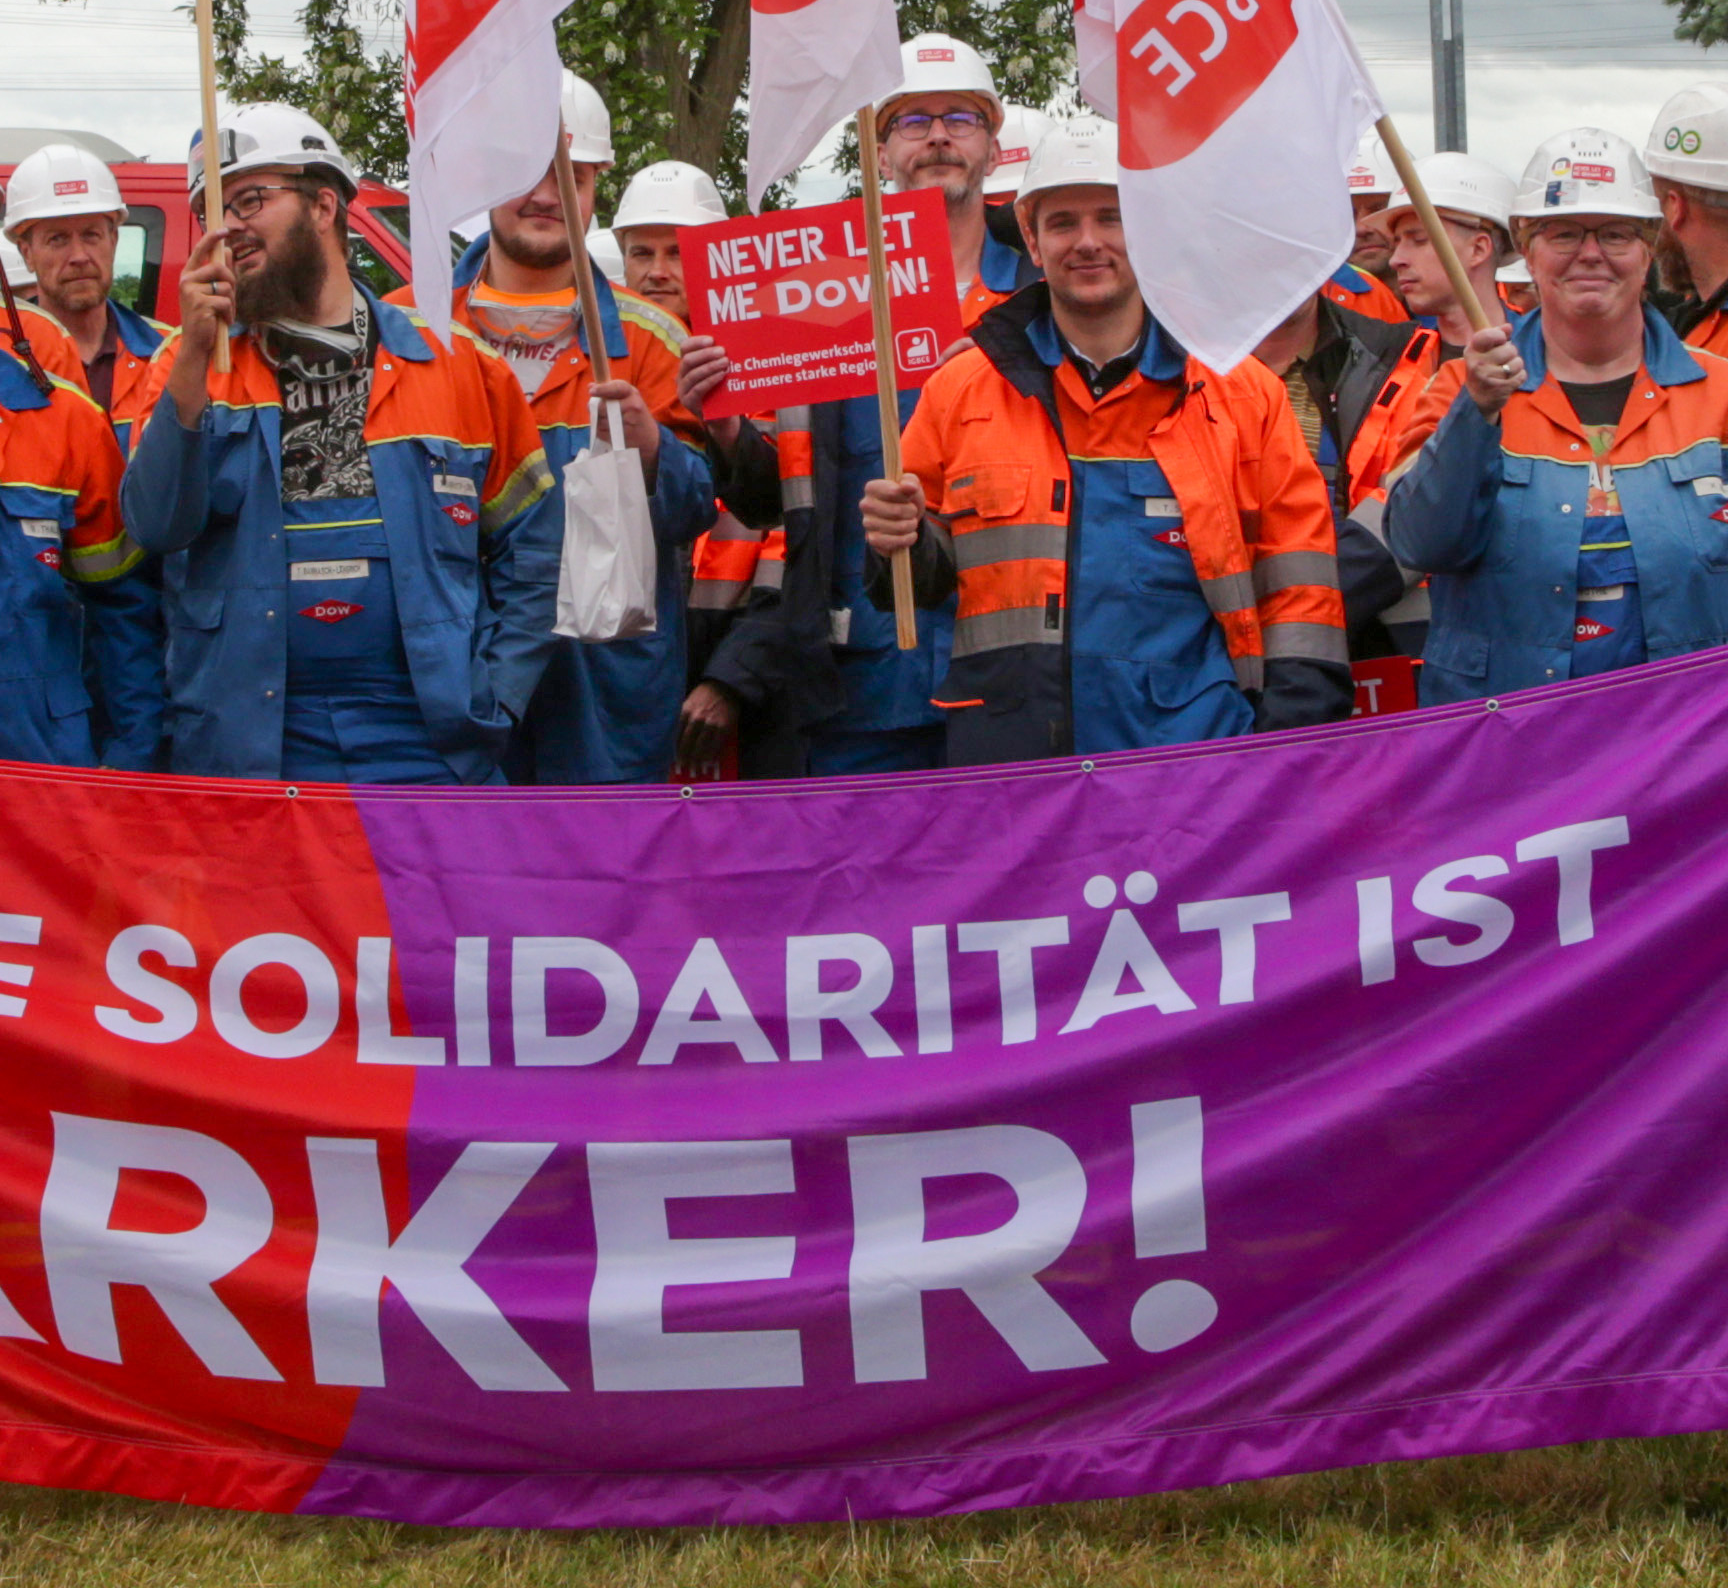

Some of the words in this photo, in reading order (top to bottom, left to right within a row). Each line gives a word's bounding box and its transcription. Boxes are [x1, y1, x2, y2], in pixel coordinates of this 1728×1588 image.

[707, 226, 827, 279] NEVER
[707, 282, 762, 325] ME
[727, 377, 747, 392] für
[749, 370, 793, 389] unsere
[796, 363, 837, 382] starke
[839, 359, 877, 380] Regio
[94, 870, 1292, 1068] SOLIDARITÄT
[1355, 816, 1630, 986] IST
